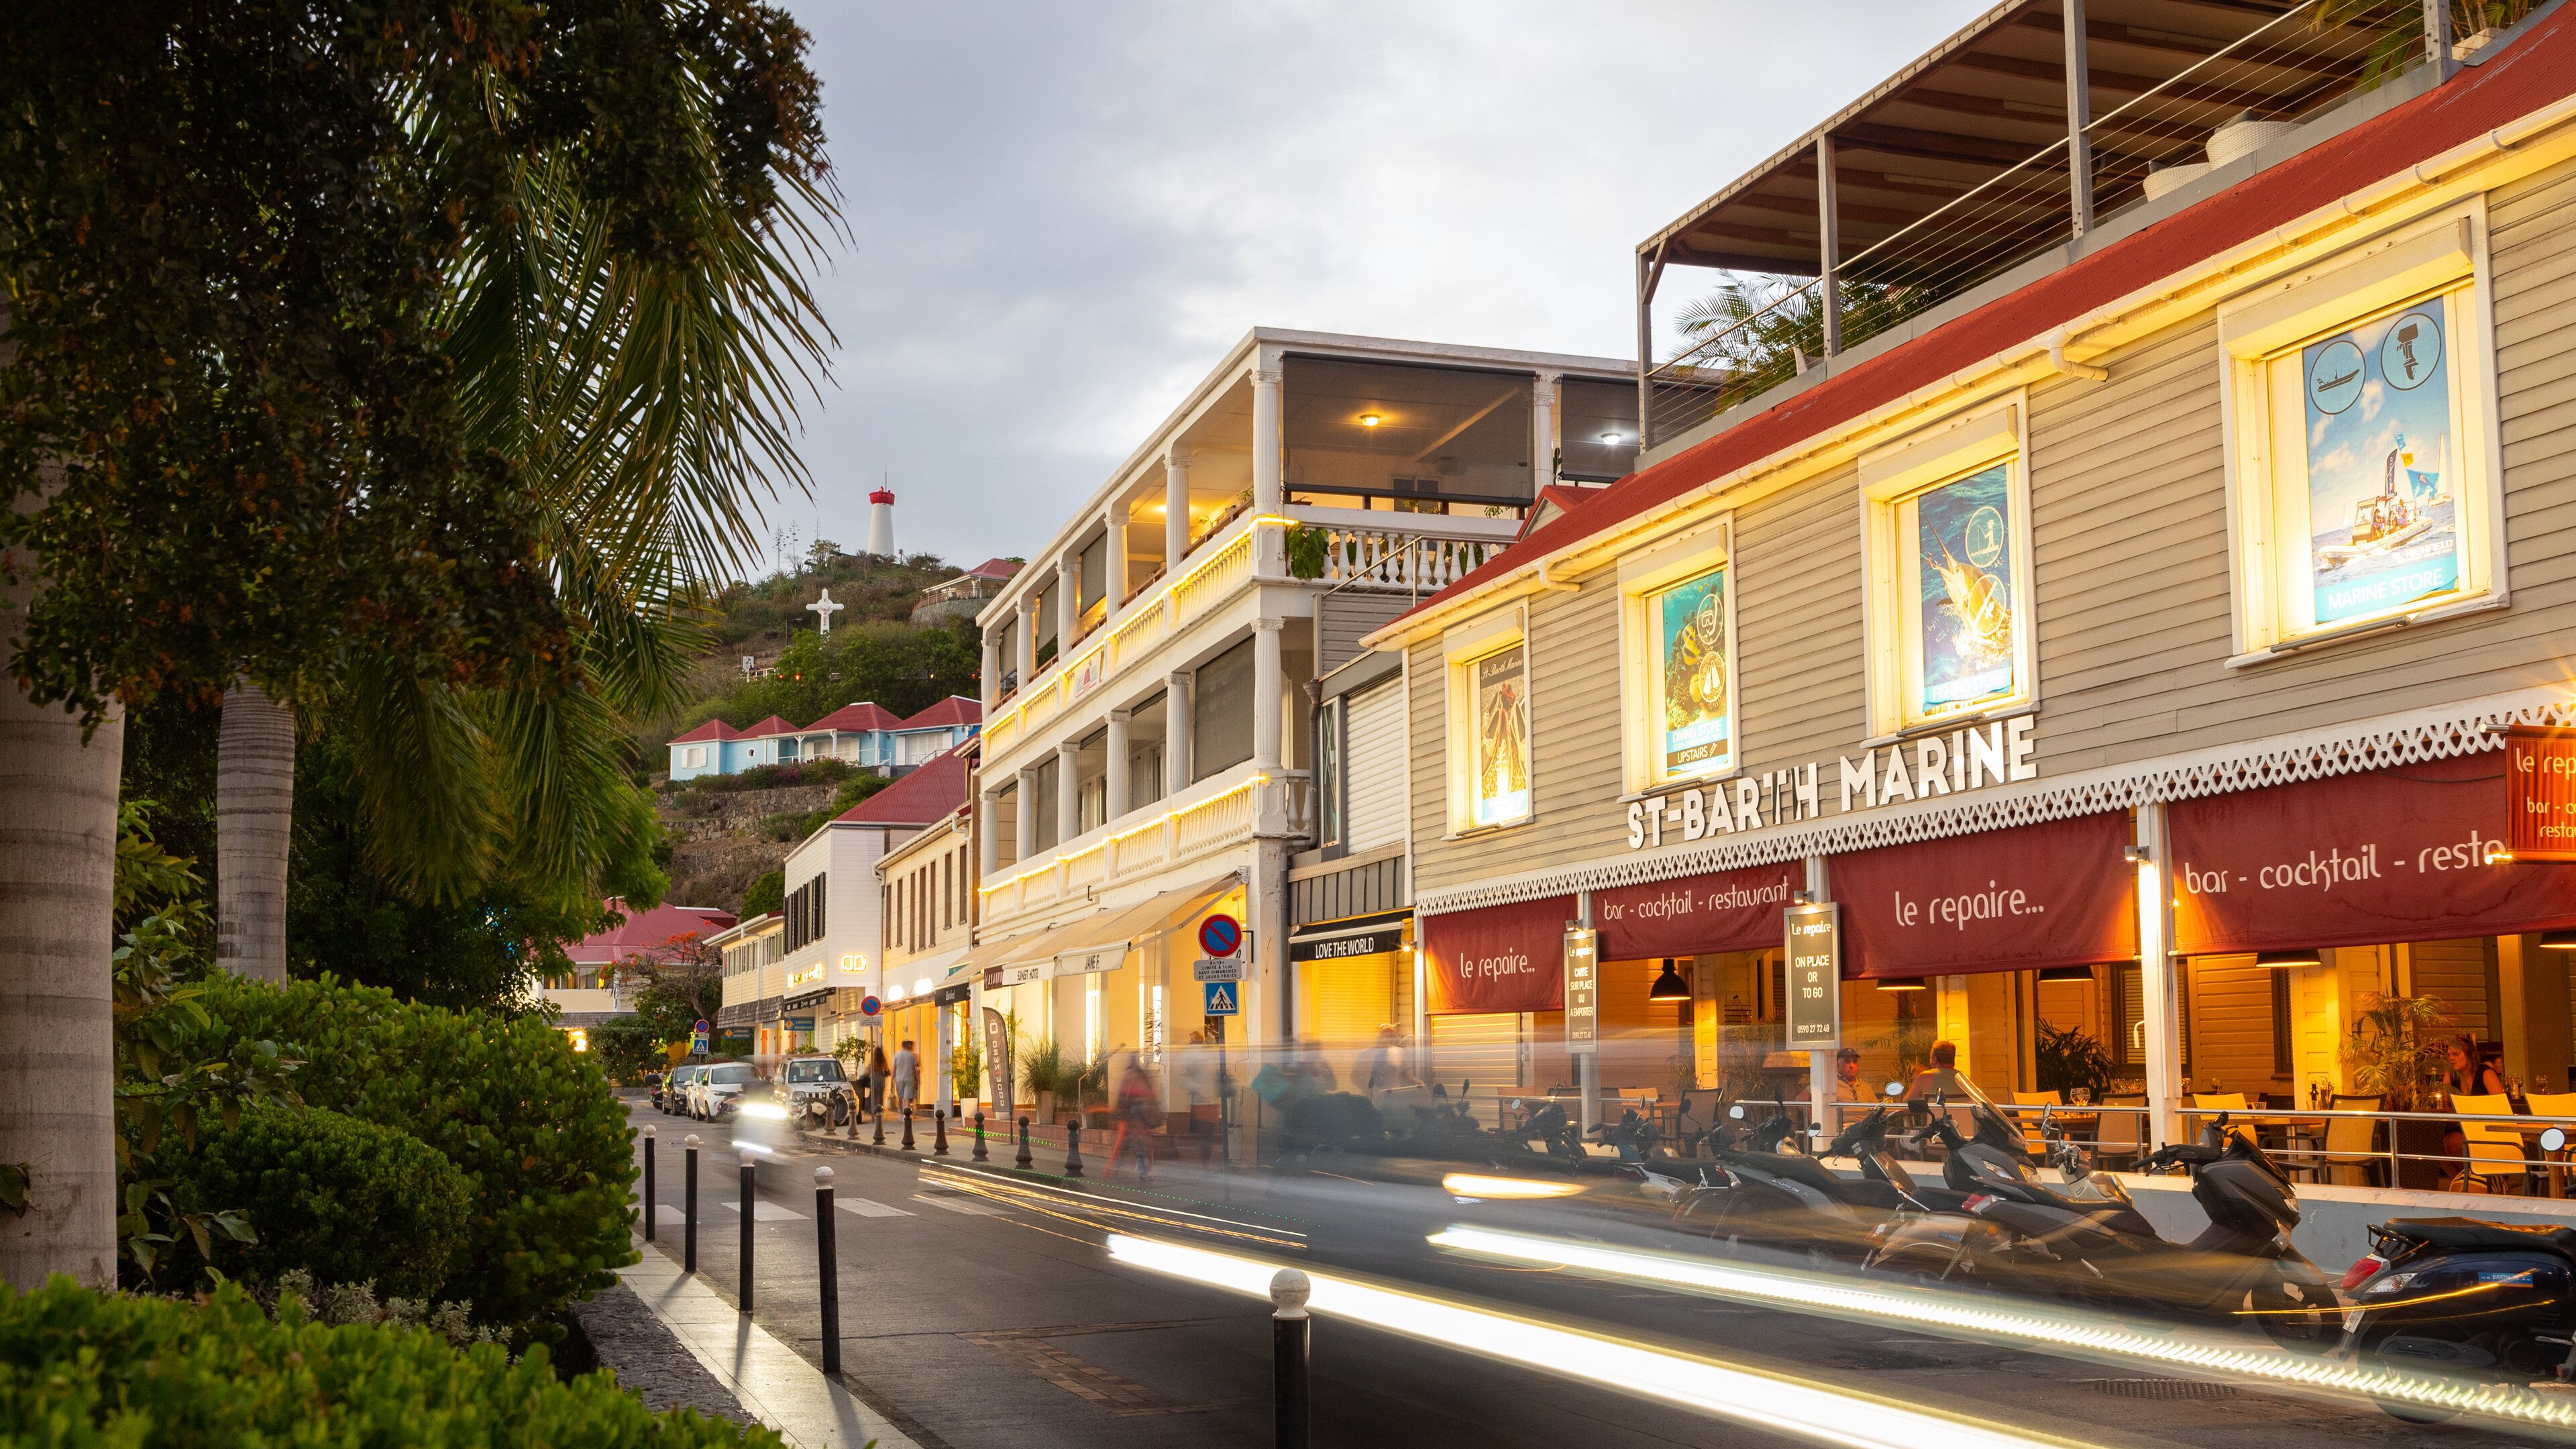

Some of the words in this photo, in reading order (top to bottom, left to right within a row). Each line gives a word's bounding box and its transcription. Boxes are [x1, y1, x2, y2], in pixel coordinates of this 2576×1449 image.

[2328, 581, 2388, 610] MARINE
[2390, 568, 2443, 596] STORE
[1481, 660, 1507, 680] St-Barth
[1505, 657, 1523, 672] Marine
[1932, 678, 1972, 700] FISHING
[1973, 670, 2006, 692] STORE
[1672, 727, 1697, 743] DIVING
[1697, 719, 1722, 737] STORE
[1677, 746, 1708, 763] UPSTAIRS
[2516, 747, 2534, 773] le
[1627, 761, 1820, 849] ST-BARTH
[1840, 714, 2038, 811] MARINE
[2526, 796, 2550, 814] bar
[2540, 821, 2576, 838] resta
[2184, 862, 2229, 895] bar
[2259, 843, 2381, 892] cocktail
[1604, 898, 1625, 920] bar
[1638, 890, 1693, 921] cocktail
[1709, 875, 1788, 911] restaurant
[1894, 891, 1918, 927] le
[1929, 879, 2044, 931] repaire...
[1791, 923, 1801, 935] Le
[1803, 920, 1832, 937] repaire
[1315, 942, 1332, 959] LOVE
[1333, 941, 1346, 957] THE
[1347, 936, 1374, 955] WORLD
[1085, 955, 1096, 971] JANE
[1460, 952, 1474, 979] le
[1479, 947, 1535, 982] repaire...
[1795, 956, 1805, 968] ON
[1807, 955, 1829, 967] PLACE
[1574, 967, 1589, 977] CARTE
[1807, 971, 1817, 983] OR
[1570, 981, 1579, 991] SUR
[1579, 979, 1593, 990] PLACE
[1803, 987, 1811, 998] TO
[1813, 987, 1823, 998] GO
[1578, 994, 1585, 1004] OU
[1573, 1006, 1594, 1017] EMPORTER
[1797, 1024, 1809, 1033] 0590
[1809, 1024, 1816, 1033] 27
[1817, 1024, 1823, 1033] 72
[1823, 1024, 1830, 1032] 48
